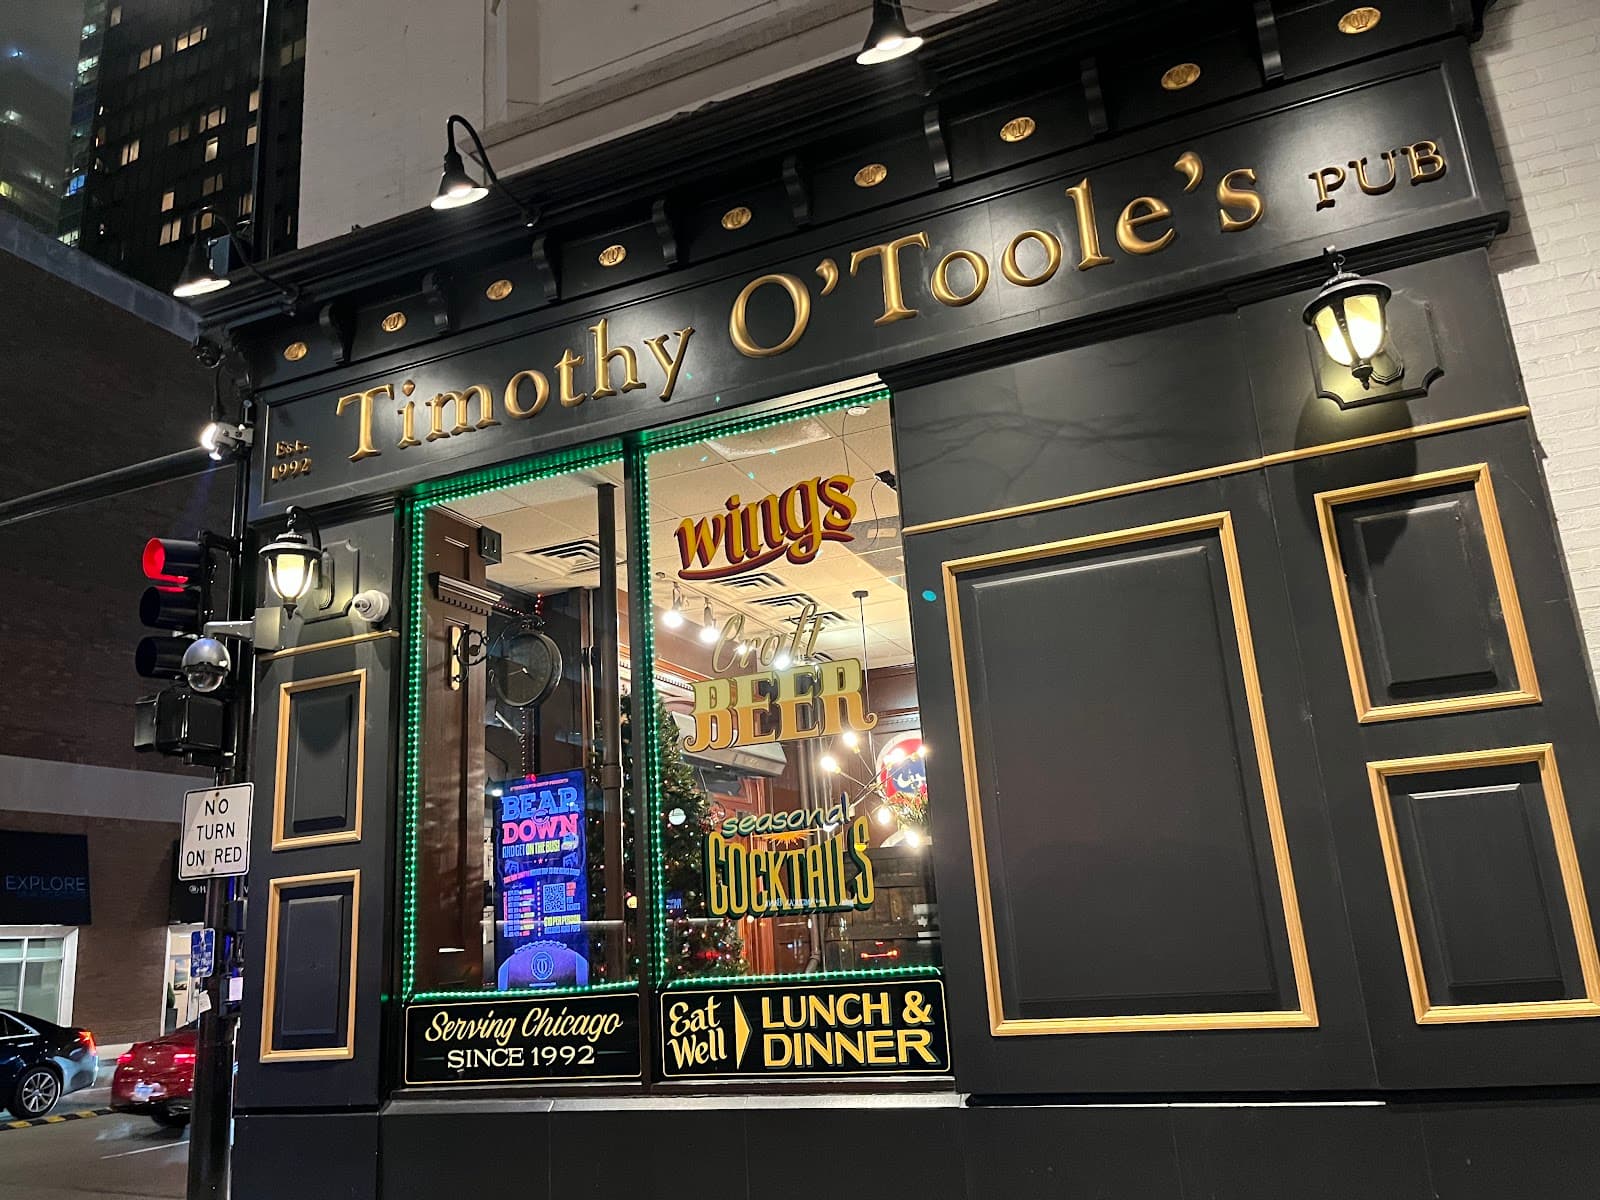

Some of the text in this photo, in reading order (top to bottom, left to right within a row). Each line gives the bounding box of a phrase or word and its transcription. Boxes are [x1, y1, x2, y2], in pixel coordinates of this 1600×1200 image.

[336, 140, 1447, 463] Timothy O'Toole's PUB
[271, 457, 312, 481] 1992
[673, 474, 857, 580] wings
[712, 603, 826, 674] Craft
[684, 658, 878, 753] BEER
[205, 798, 229, 816] NO
[501, 787, 580, 821] BEAR
[722, 791, 851, 838] seasonal
[197, 822, 236, 841] TURN
[502, 813, 579, 844] DOWN
[186, 846, 242, 866] ON RED
[703, 815, 875, 920] COCKTAILS
[5, 875, 86, 891] EXPLORE
[425, 1007, 623, 1046] Serving Chicago
[669, 990, 934, 1036] Eat LUNCH &
[447, 1045, 595, 1069] SINCE 1992
[667, 1027, 939, 1070] Well DINNER
